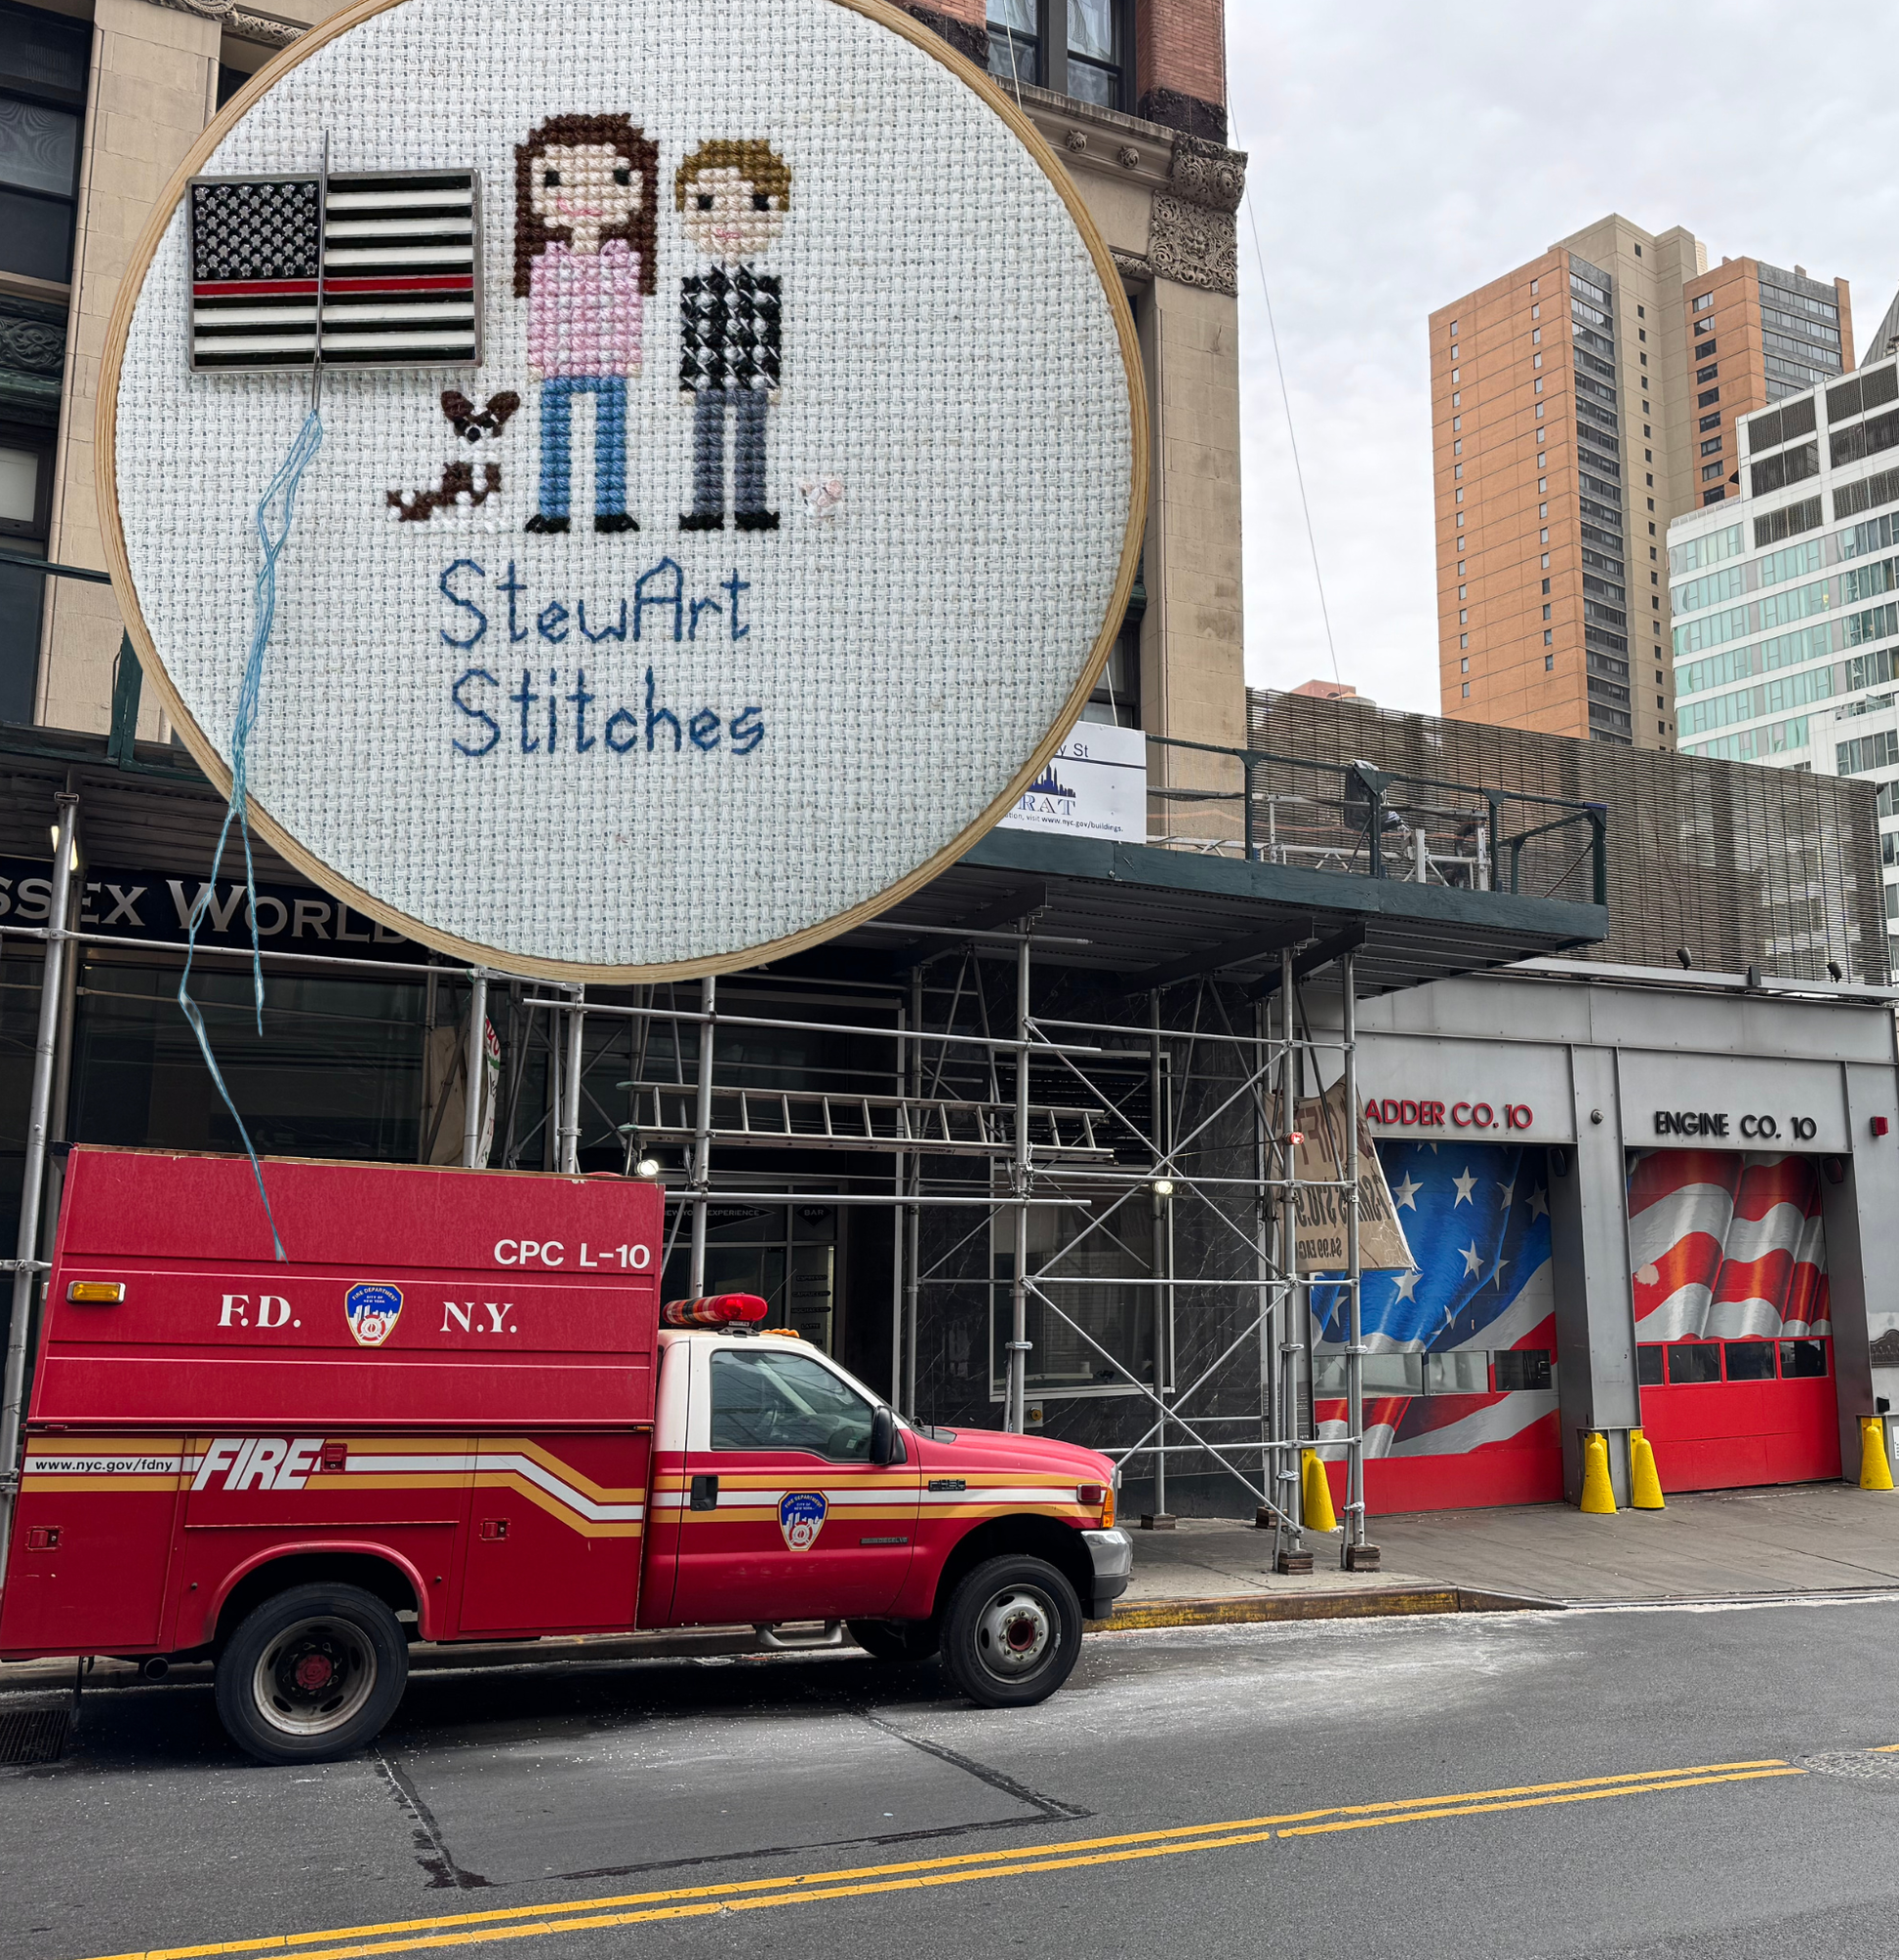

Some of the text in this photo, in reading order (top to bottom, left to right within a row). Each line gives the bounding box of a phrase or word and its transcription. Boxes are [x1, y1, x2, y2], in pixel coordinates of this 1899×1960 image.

[439, 556, 750, 649] StewArt
[452, 665, 764, 756] Stitches
[1073, 742, 1089, 758] St
[1027, 814, 1040, 822] visit
[1041, 817, 1124, 832] www.nyc.gov/buildings.
[1452, 1101, 1499, 1129] CO.
[1504, 1104, 1533, 1129] 10
[1654, 1111, 1817, 1140] ENGINE CO. 10
[494, 1239, 651, 1269] CPC L-10
[351, 1287, 398, 1302] FIRE DEPARTMENT
[217, 1294, 518, 1334] F.D. N.Y.
[35, 1438, 326, 1491] www.nyc.gov/fdny FIRE
[785, 1495, 824, 1509] FIRE DEPARTMENT
